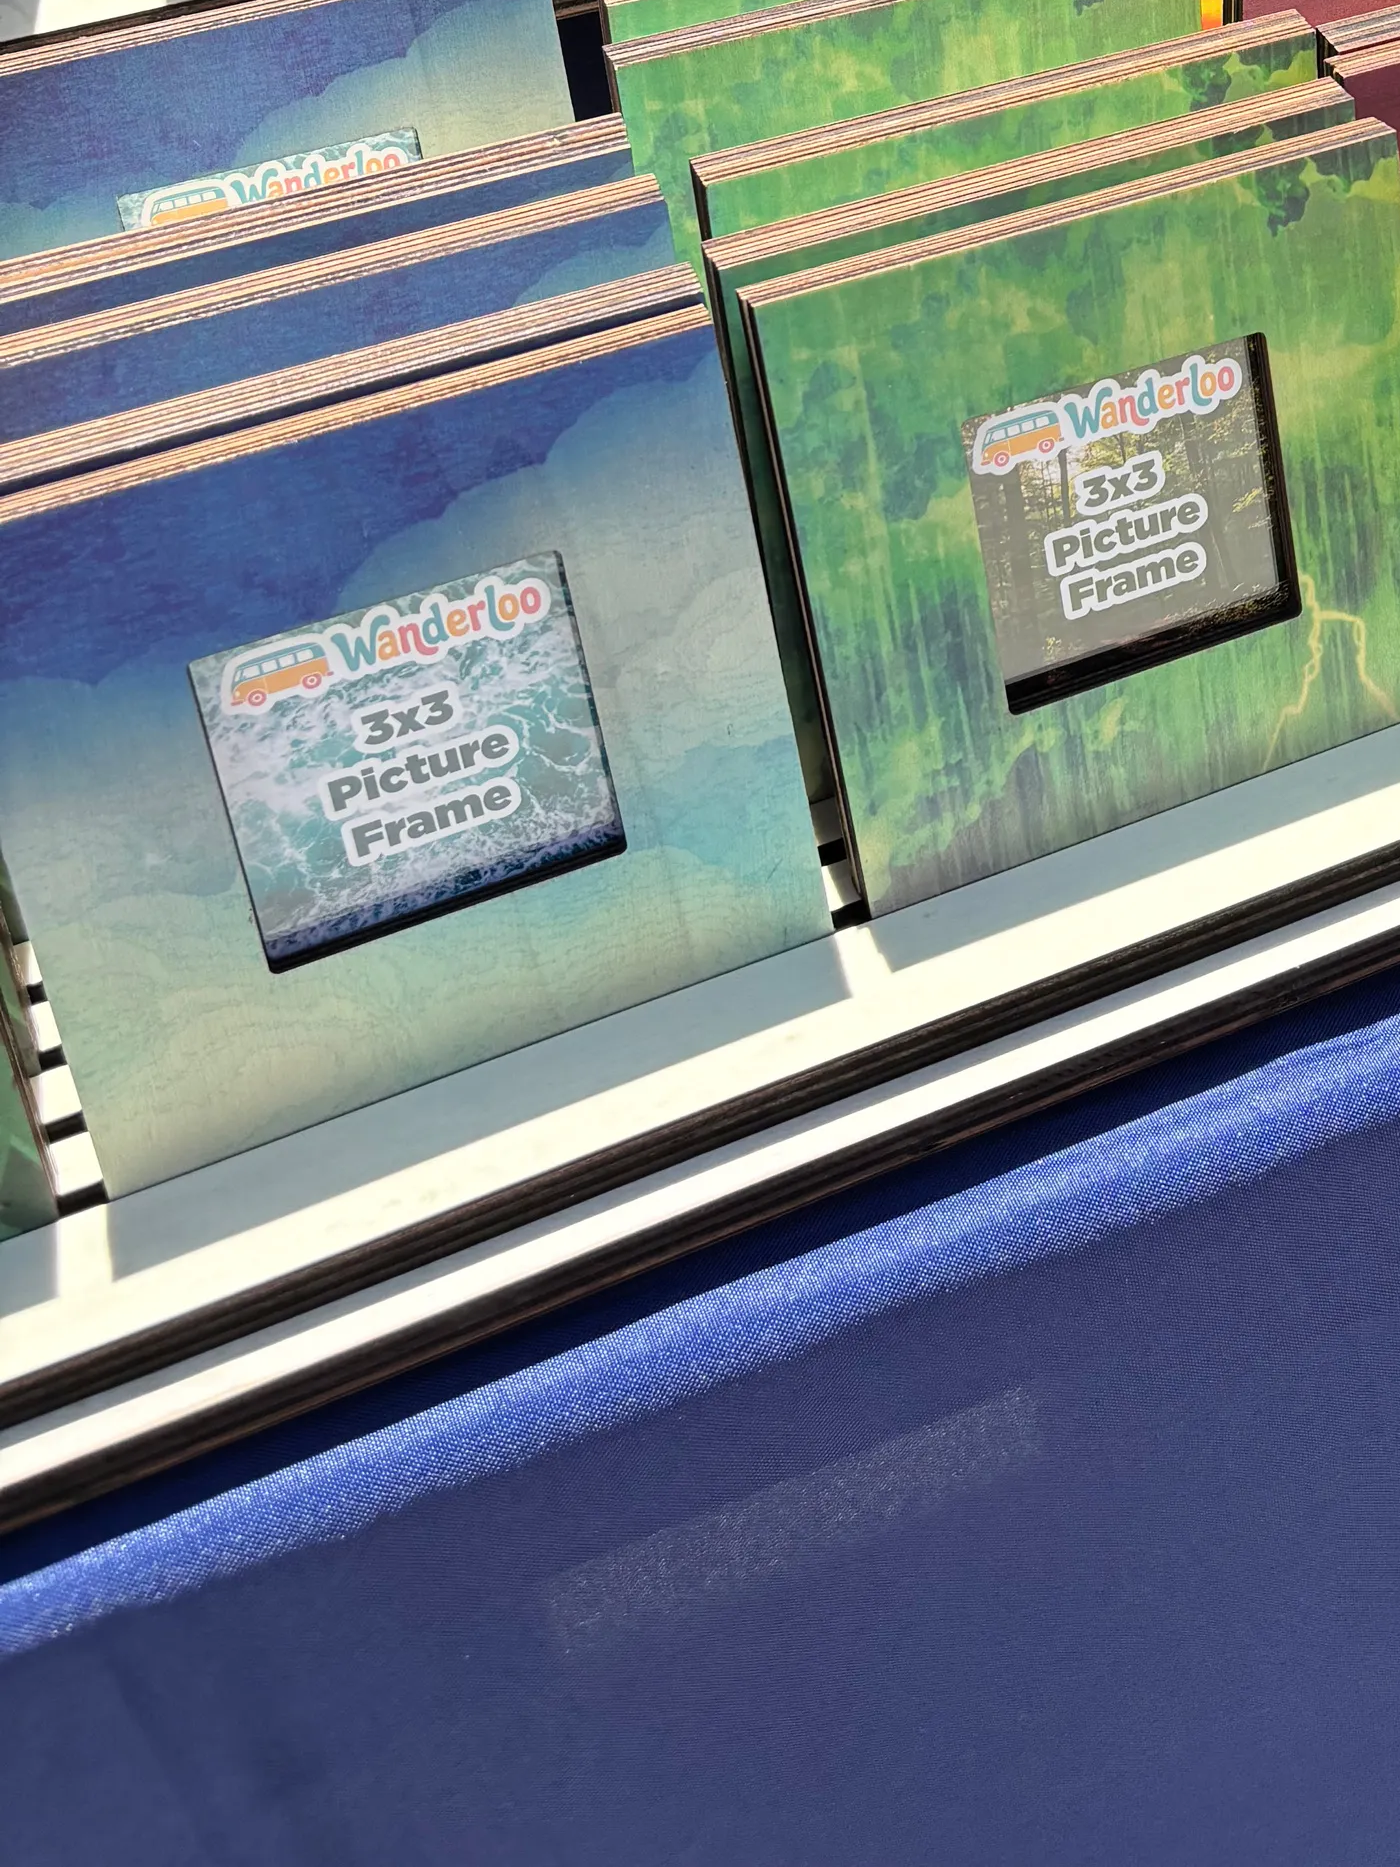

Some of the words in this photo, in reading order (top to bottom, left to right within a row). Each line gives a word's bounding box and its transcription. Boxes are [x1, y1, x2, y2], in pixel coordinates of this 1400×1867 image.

[1064, 362, 1235, 439] Wanderloo
[1082, 458, 1159, 509] 3x3
[1052, 499, 1201, 569] Picture
[1068, 548, 1199, 613] Frame
[331, 584, 542, 672] Wanderloo
[360, 689, 454, 745] 3x3
[326, 732, 510, 812] Picture
[350, 783, 513, 859] Frame
